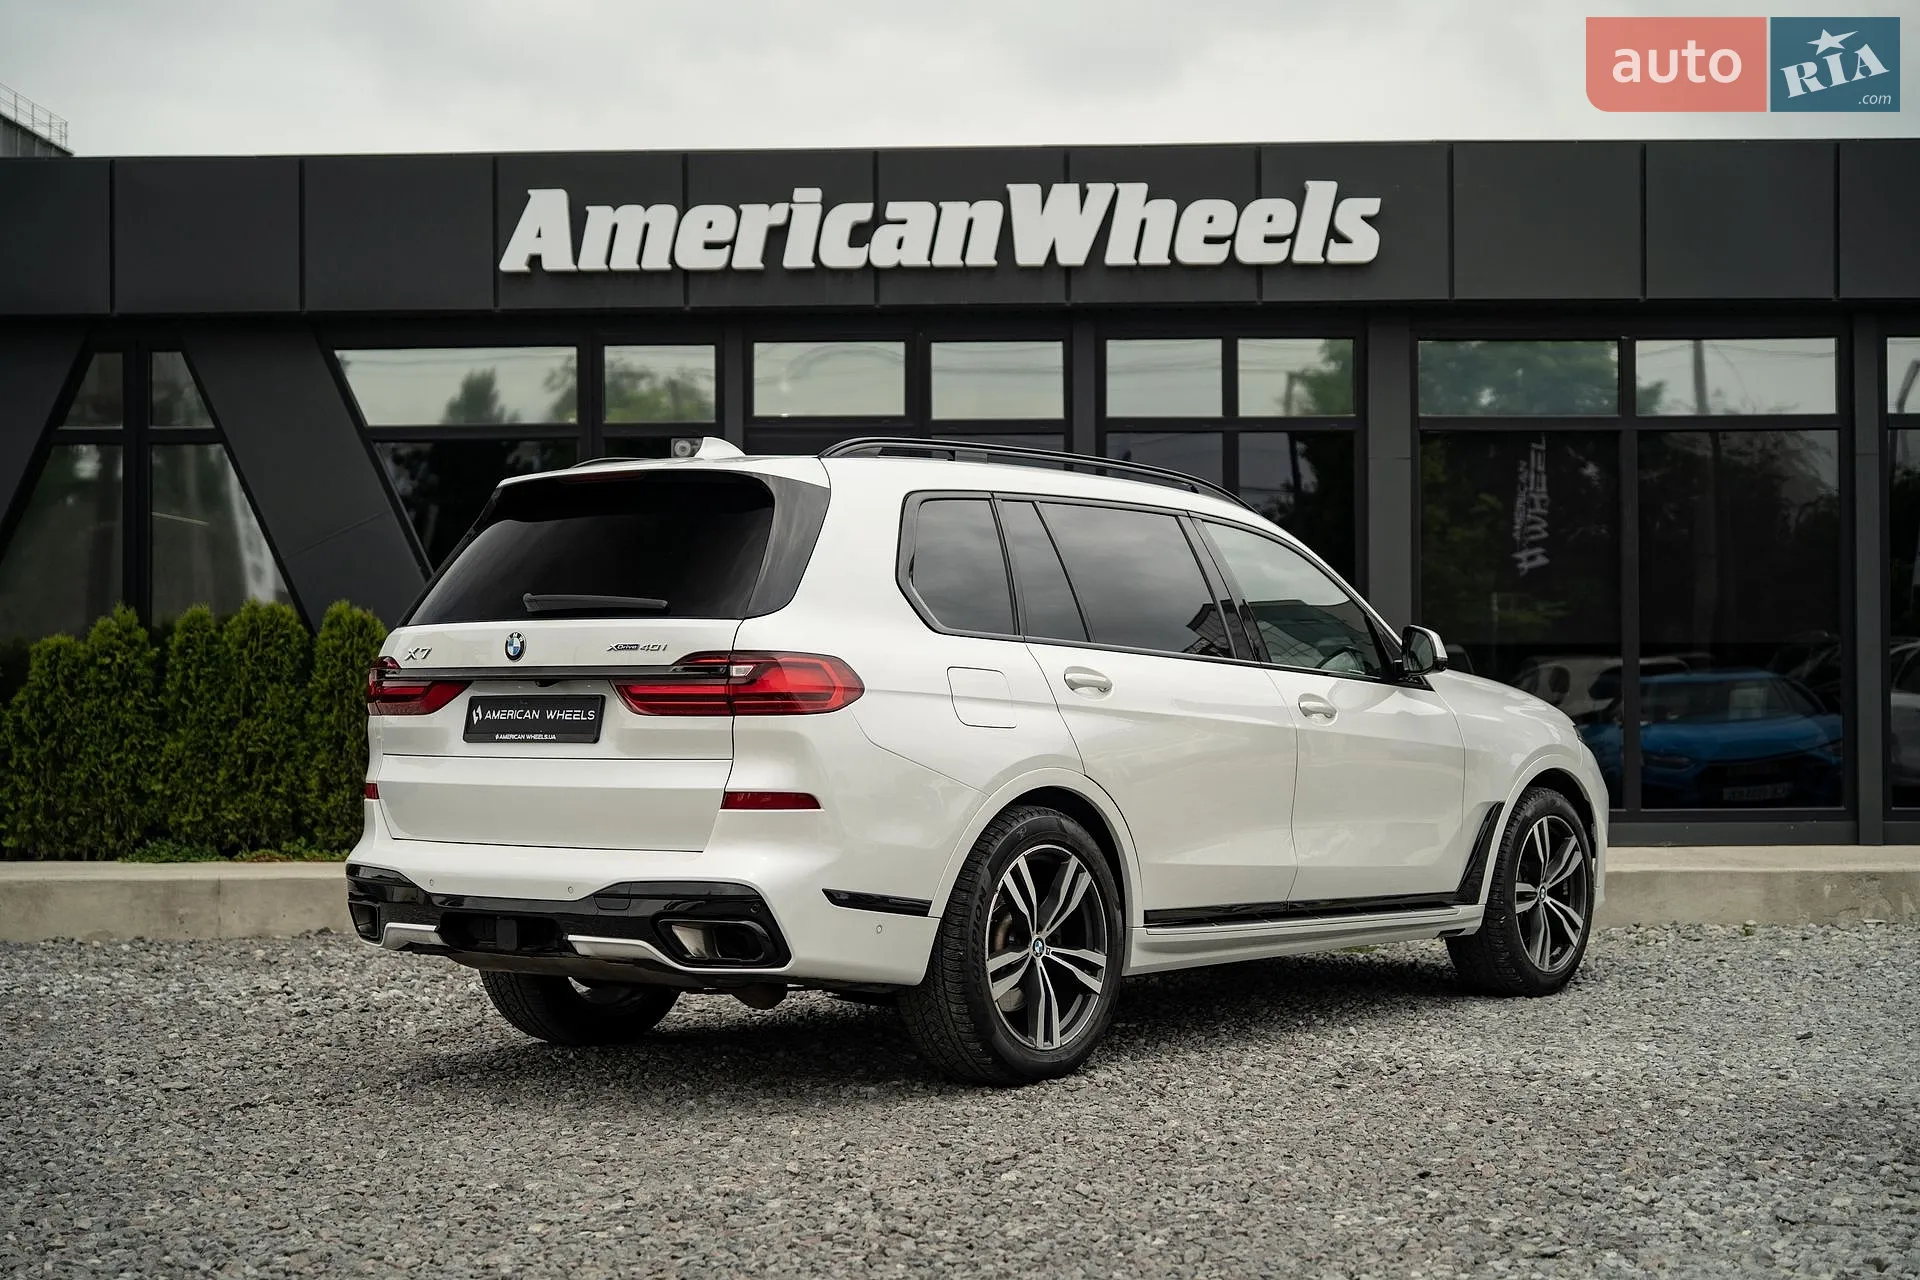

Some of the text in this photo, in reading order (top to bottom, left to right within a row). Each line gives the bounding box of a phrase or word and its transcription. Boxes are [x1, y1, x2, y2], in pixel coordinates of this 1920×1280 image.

[499, 180, 1382, 274] AmericanWheels
[404, 647, 433, 661] X7
[484, 708, 596, 721] AMERICAN WHEELS
[499, 733, 526, 741] AMERICAN
